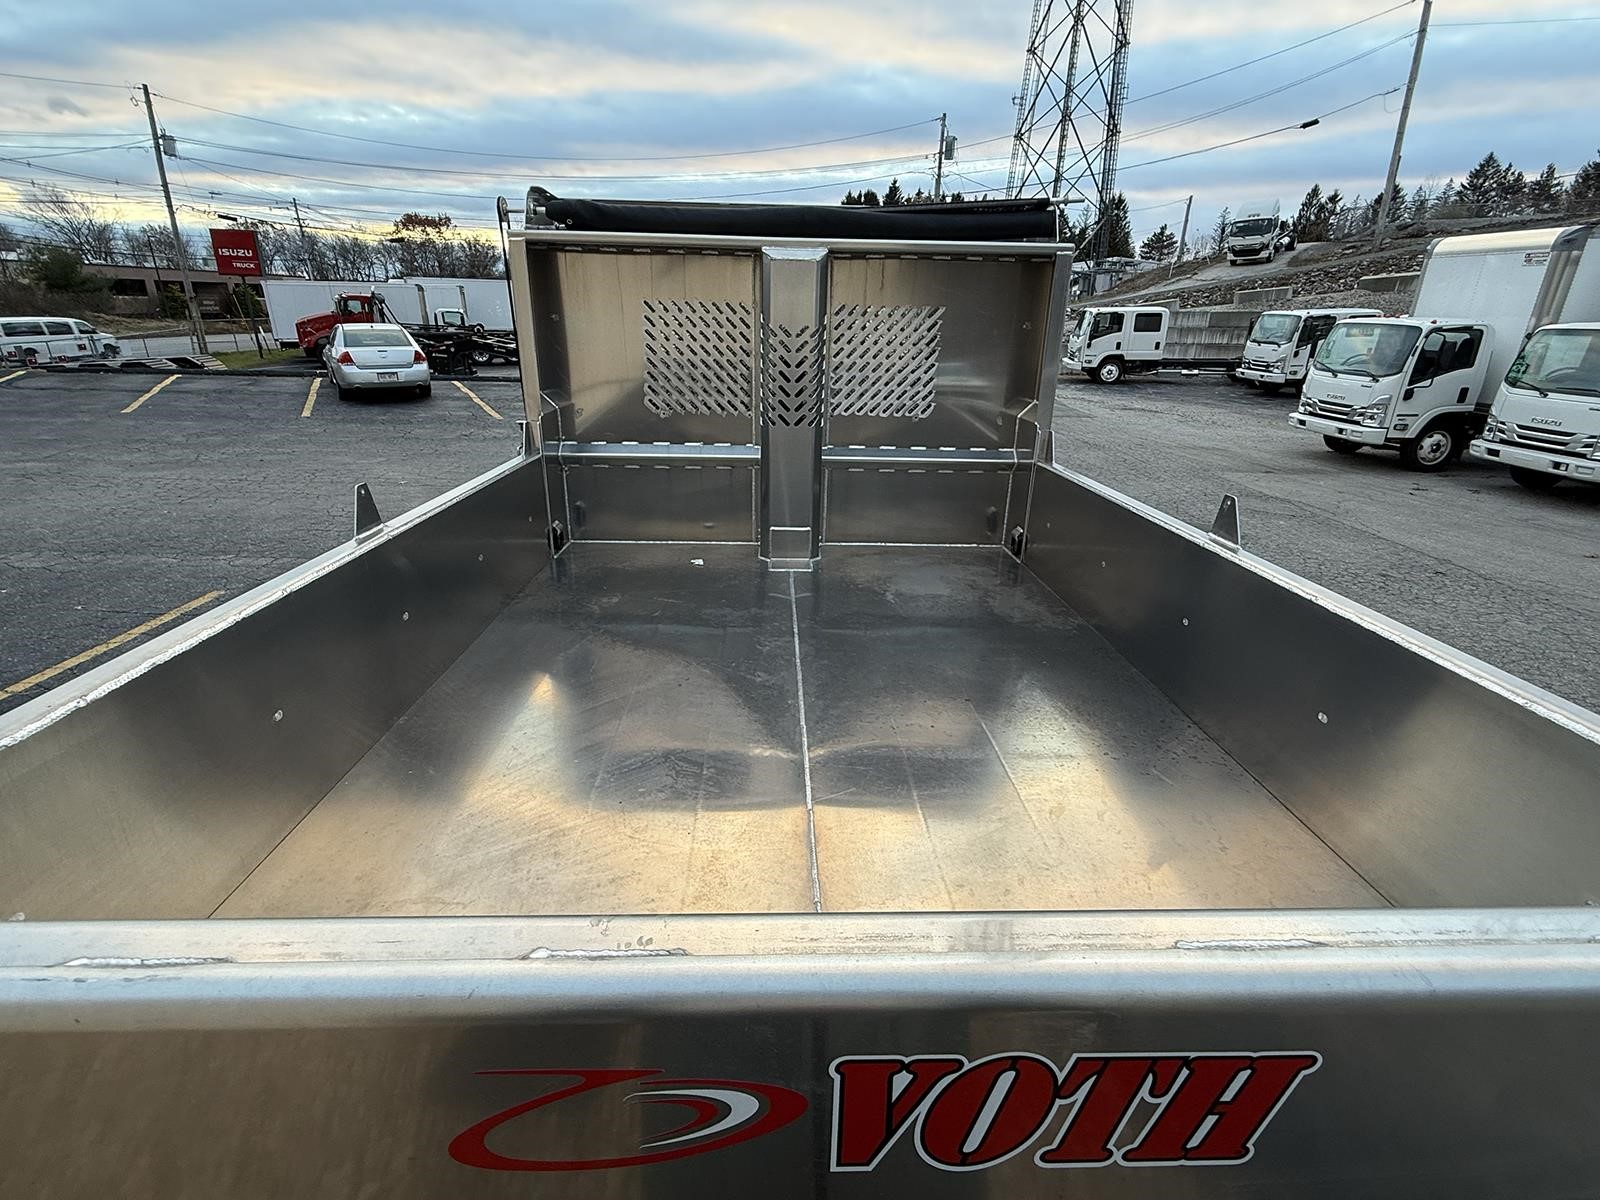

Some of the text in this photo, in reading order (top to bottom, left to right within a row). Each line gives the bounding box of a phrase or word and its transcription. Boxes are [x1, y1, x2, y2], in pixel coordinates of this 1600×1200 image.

[217, 248, 253, 257] ISUZU
[1530, 416, 1563, 427] ISUZU
[829, 1051, 1322, 1172] VOTH
